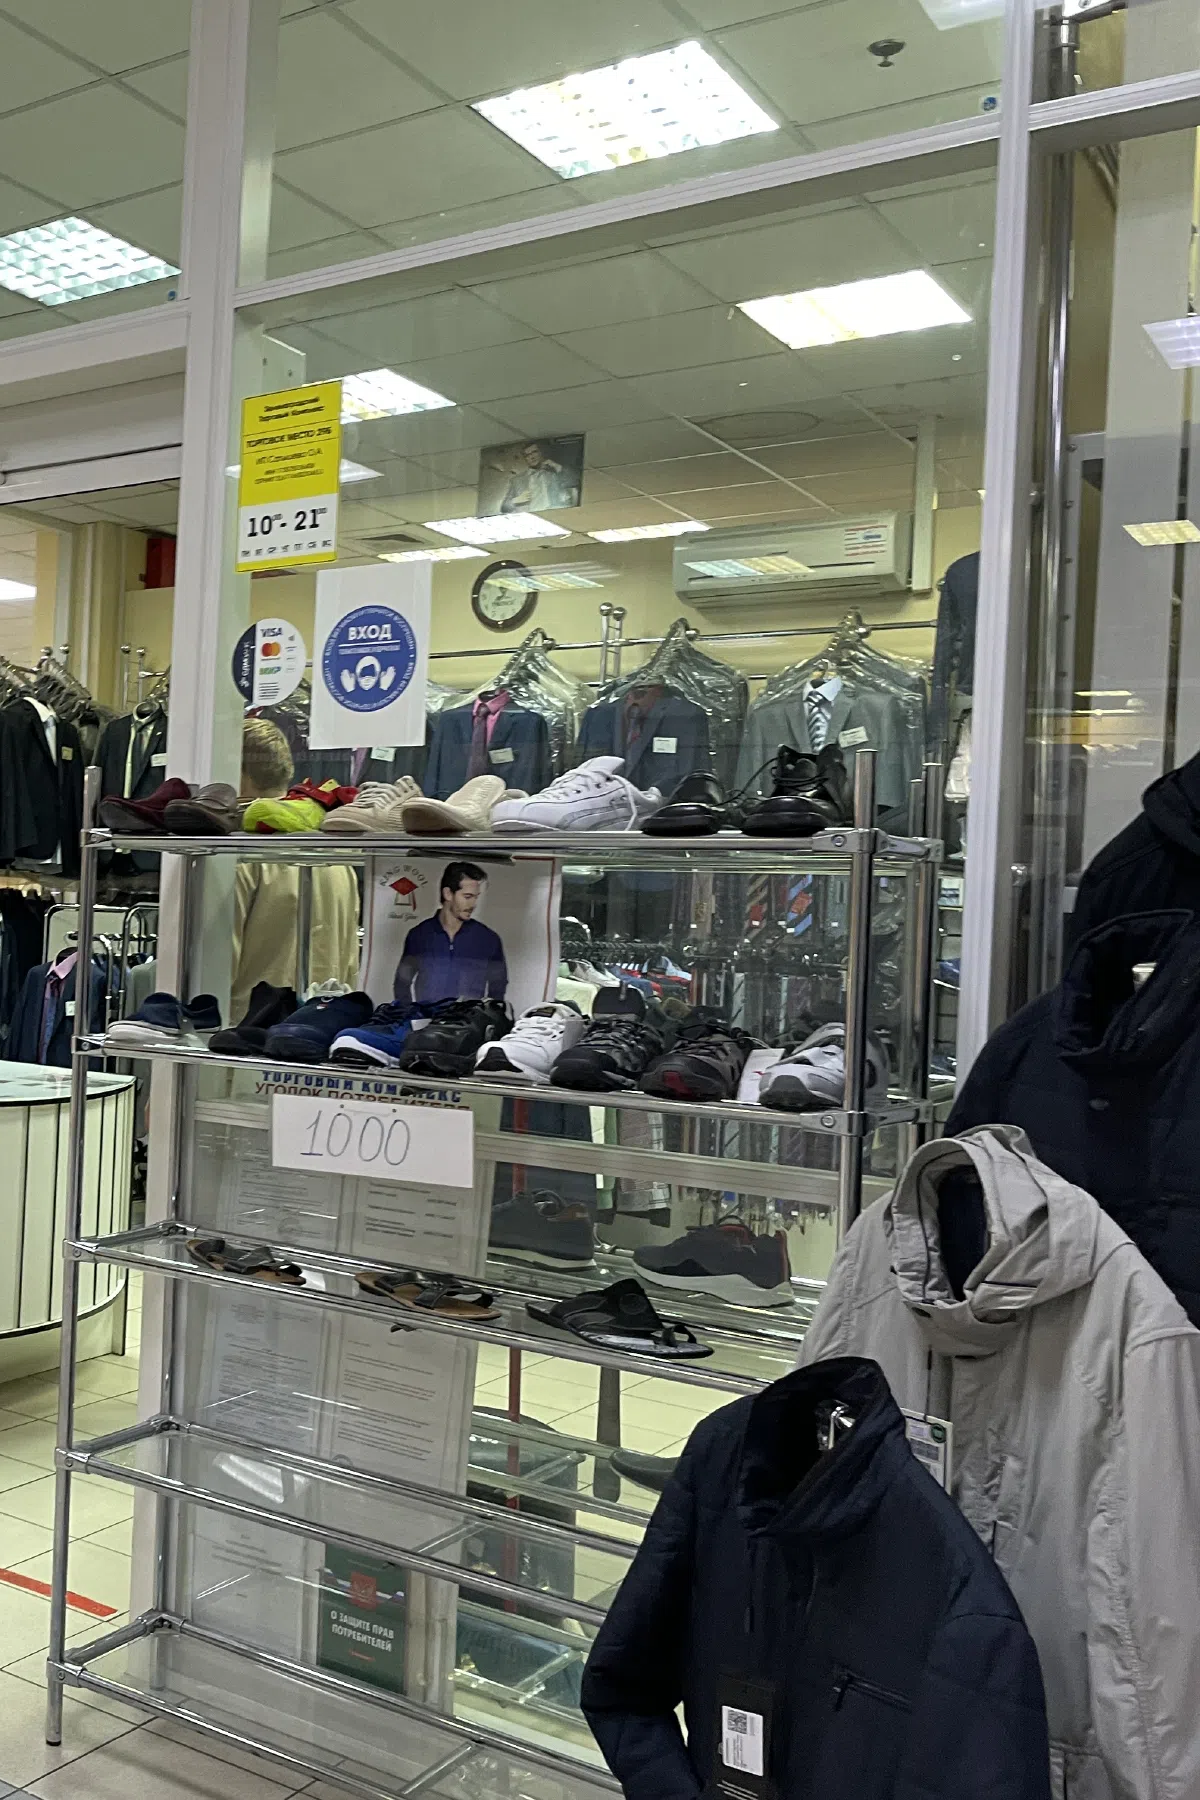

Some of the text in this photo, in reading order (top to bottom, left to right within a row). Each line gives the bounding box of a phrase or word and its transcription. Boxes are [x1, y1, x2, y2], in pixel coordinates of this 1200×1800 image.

[260, 627, 283, 638] VISA
[347, 623, 393, 641] ВХОД
[300, 1110, 410, 1166] 1000
[330, 1610, 395, 1639] О ЗАЩИТЕ ПРАВ
[331, 1624, 392, 1652] ПОТРЕБИТЕЛЕЙ
